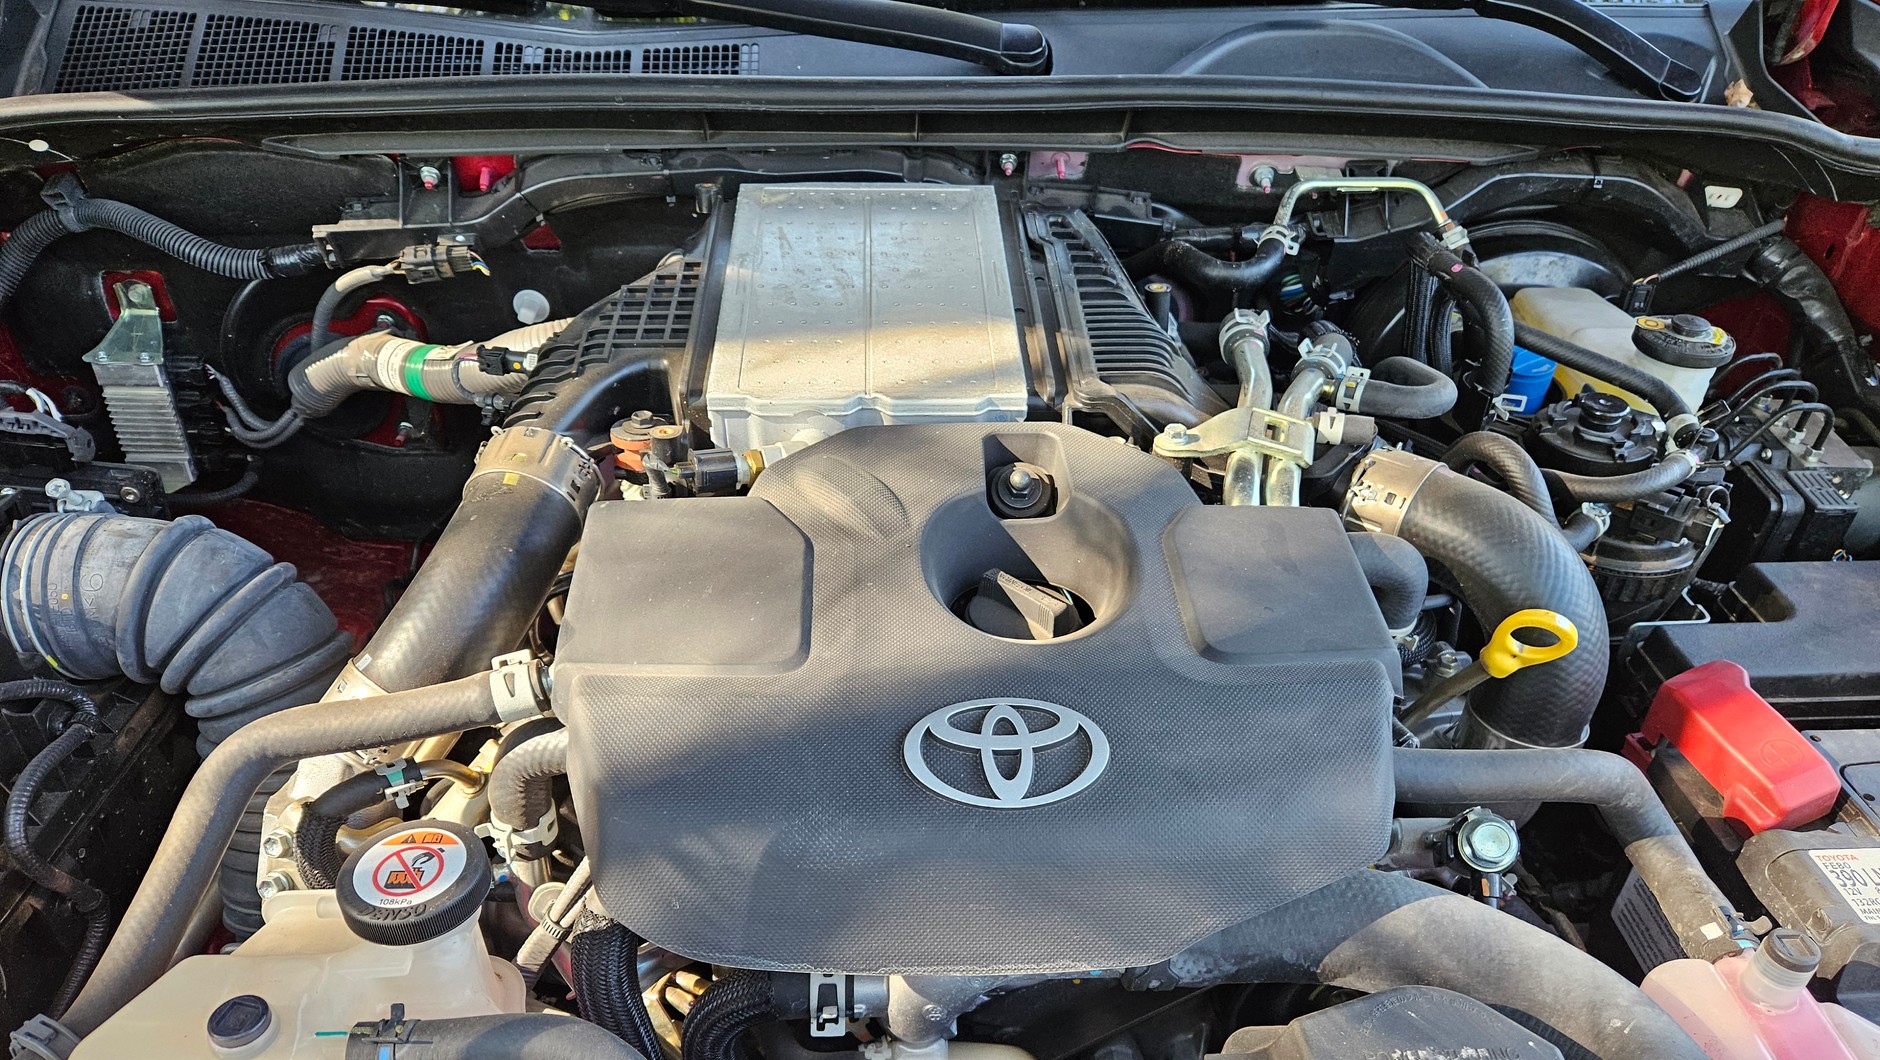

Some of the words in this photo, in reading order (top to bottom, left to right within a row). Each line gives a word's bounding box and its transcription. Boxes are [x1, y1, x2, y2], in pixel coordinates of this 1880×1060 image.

[1815, 854, 1859, 862] TOYOTA
[1829, 869, 1868, 887] 390
[1843, 887, 1862, 896] 12V
[379, 898, 412, 906] 108kPa
[356, 904, 427, 921] DENSO
